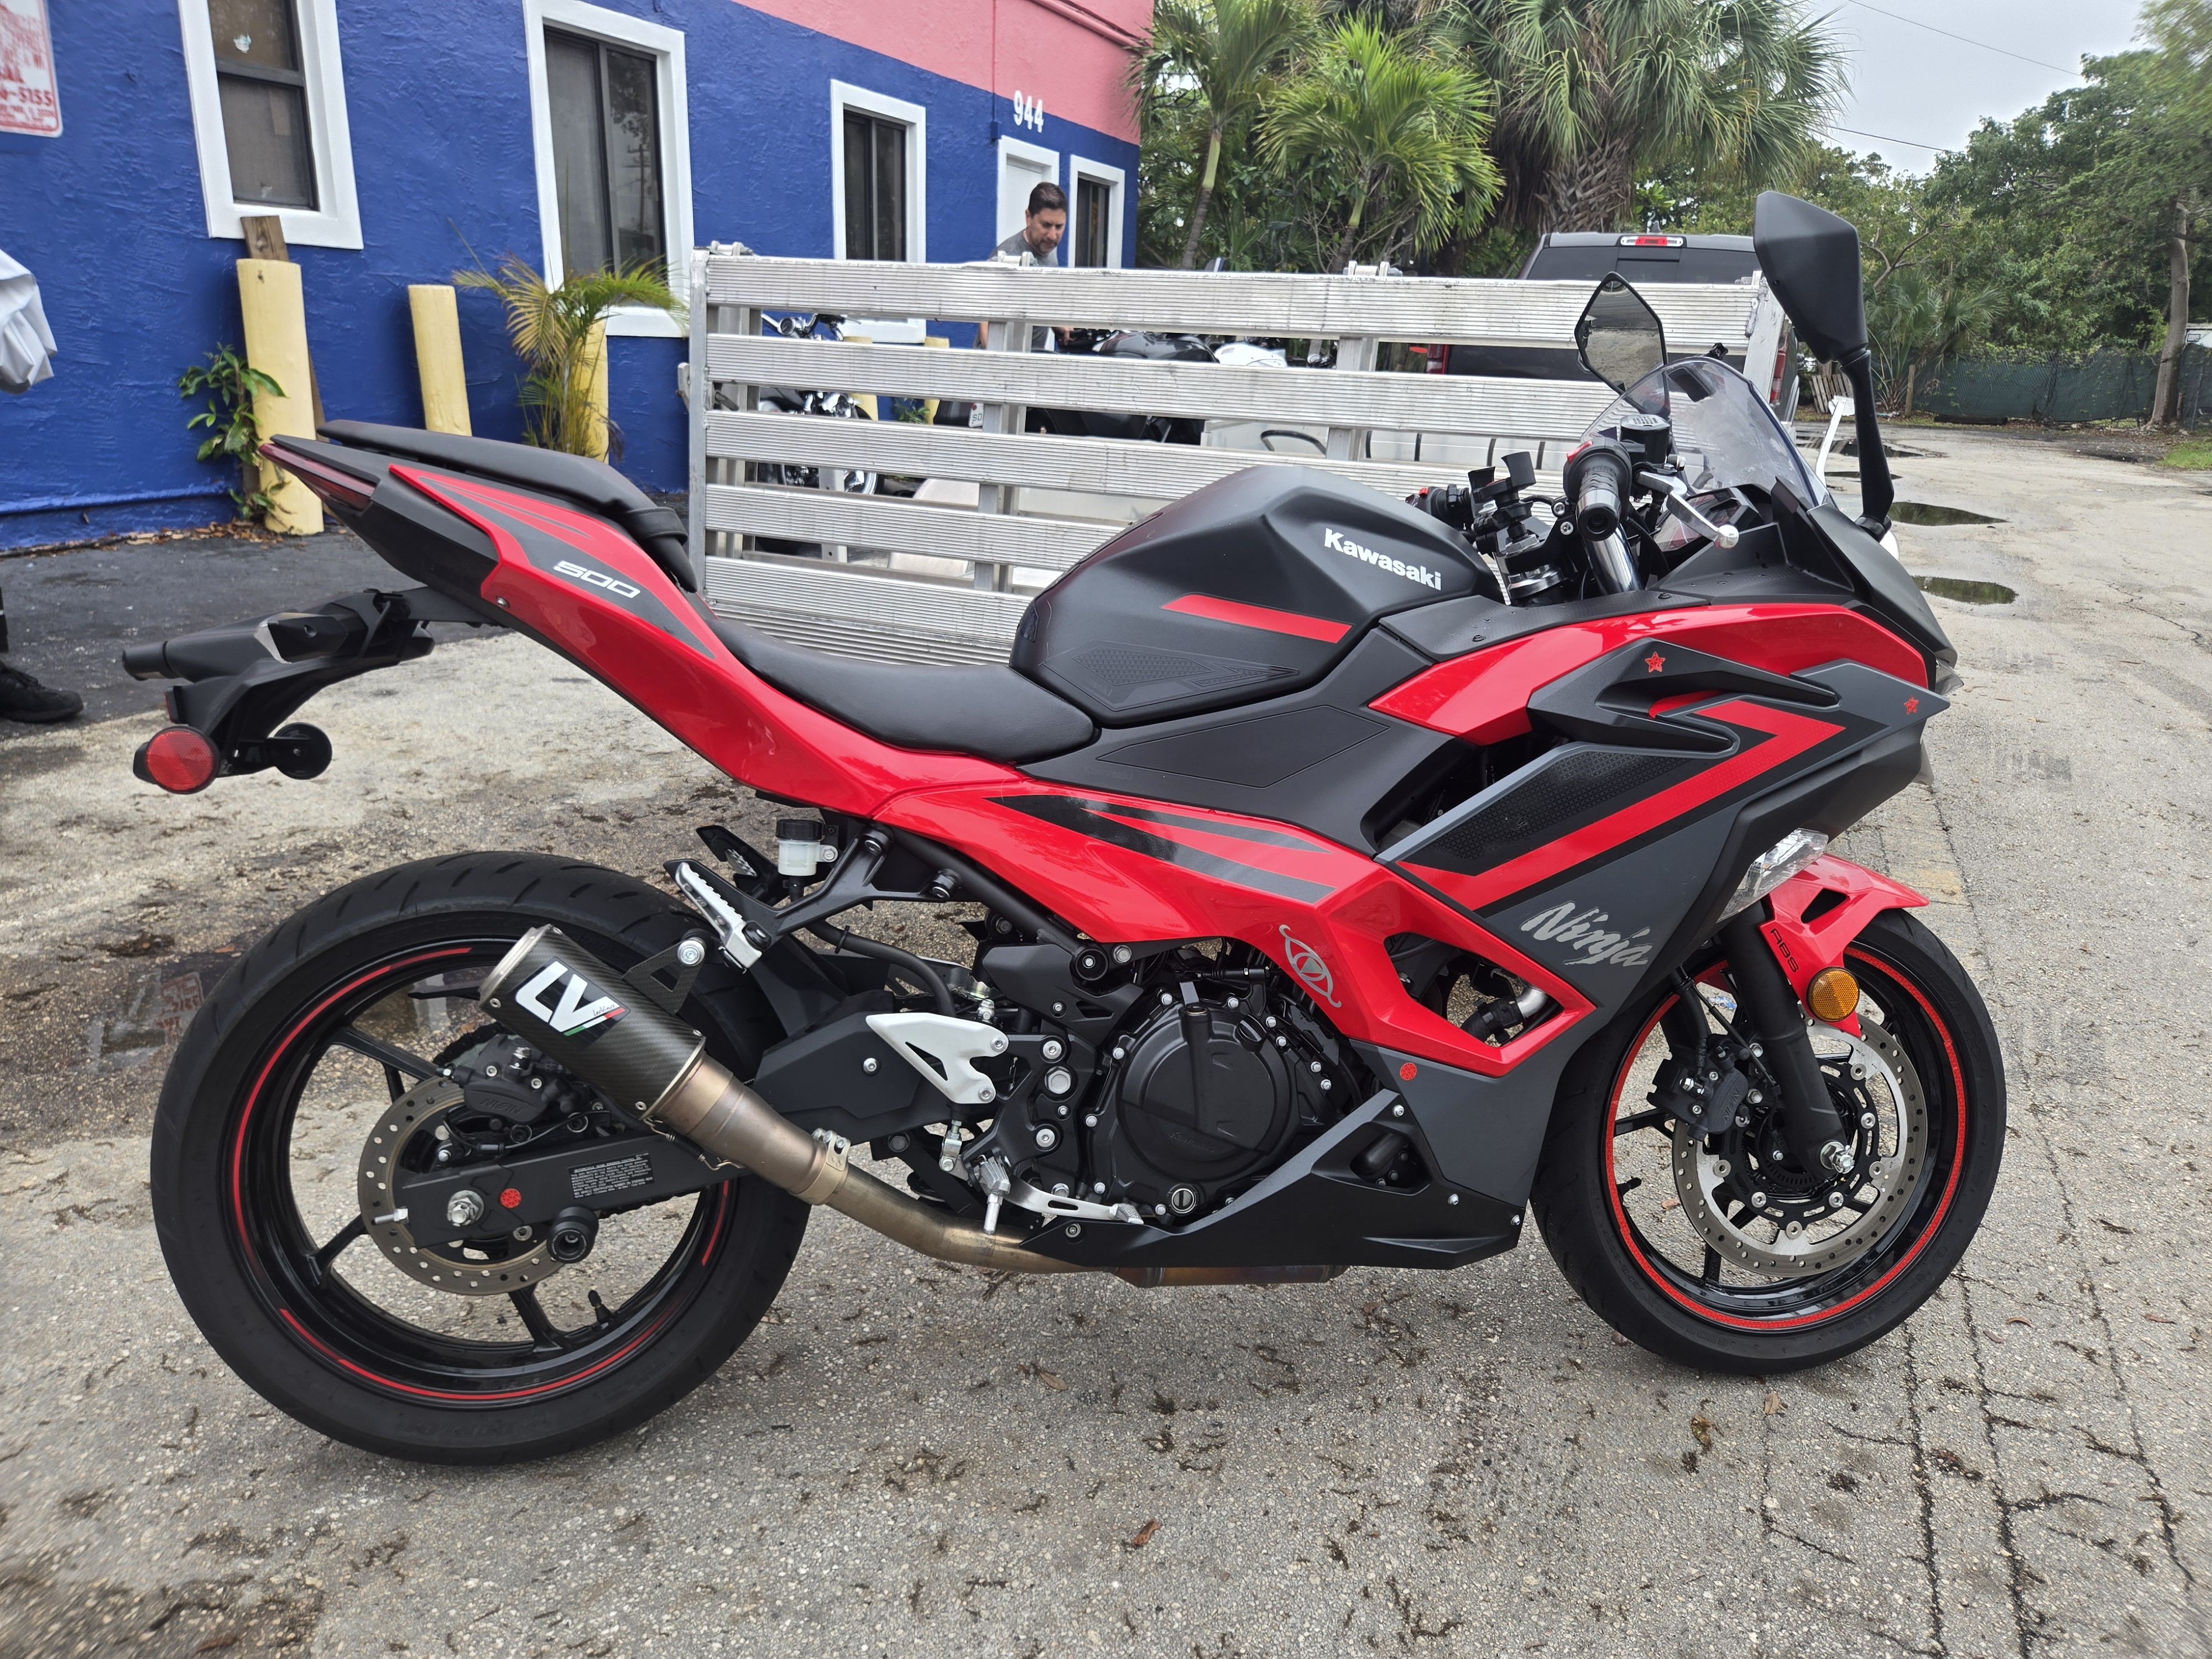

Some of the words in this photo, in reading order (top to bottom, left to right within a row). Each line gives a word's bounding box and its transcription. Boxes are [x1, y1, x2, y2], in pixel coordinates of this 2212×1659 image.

[1013, 90, 1044, 133] 944
[554, 560, 641, 598] 500
[1324, 528, 1442, 591] Kawasaki
[1520, 901, 1653, 967] Ninja
[1770, 928, 1799, 973] ABS
[515, 961, 620, 1032] LV
